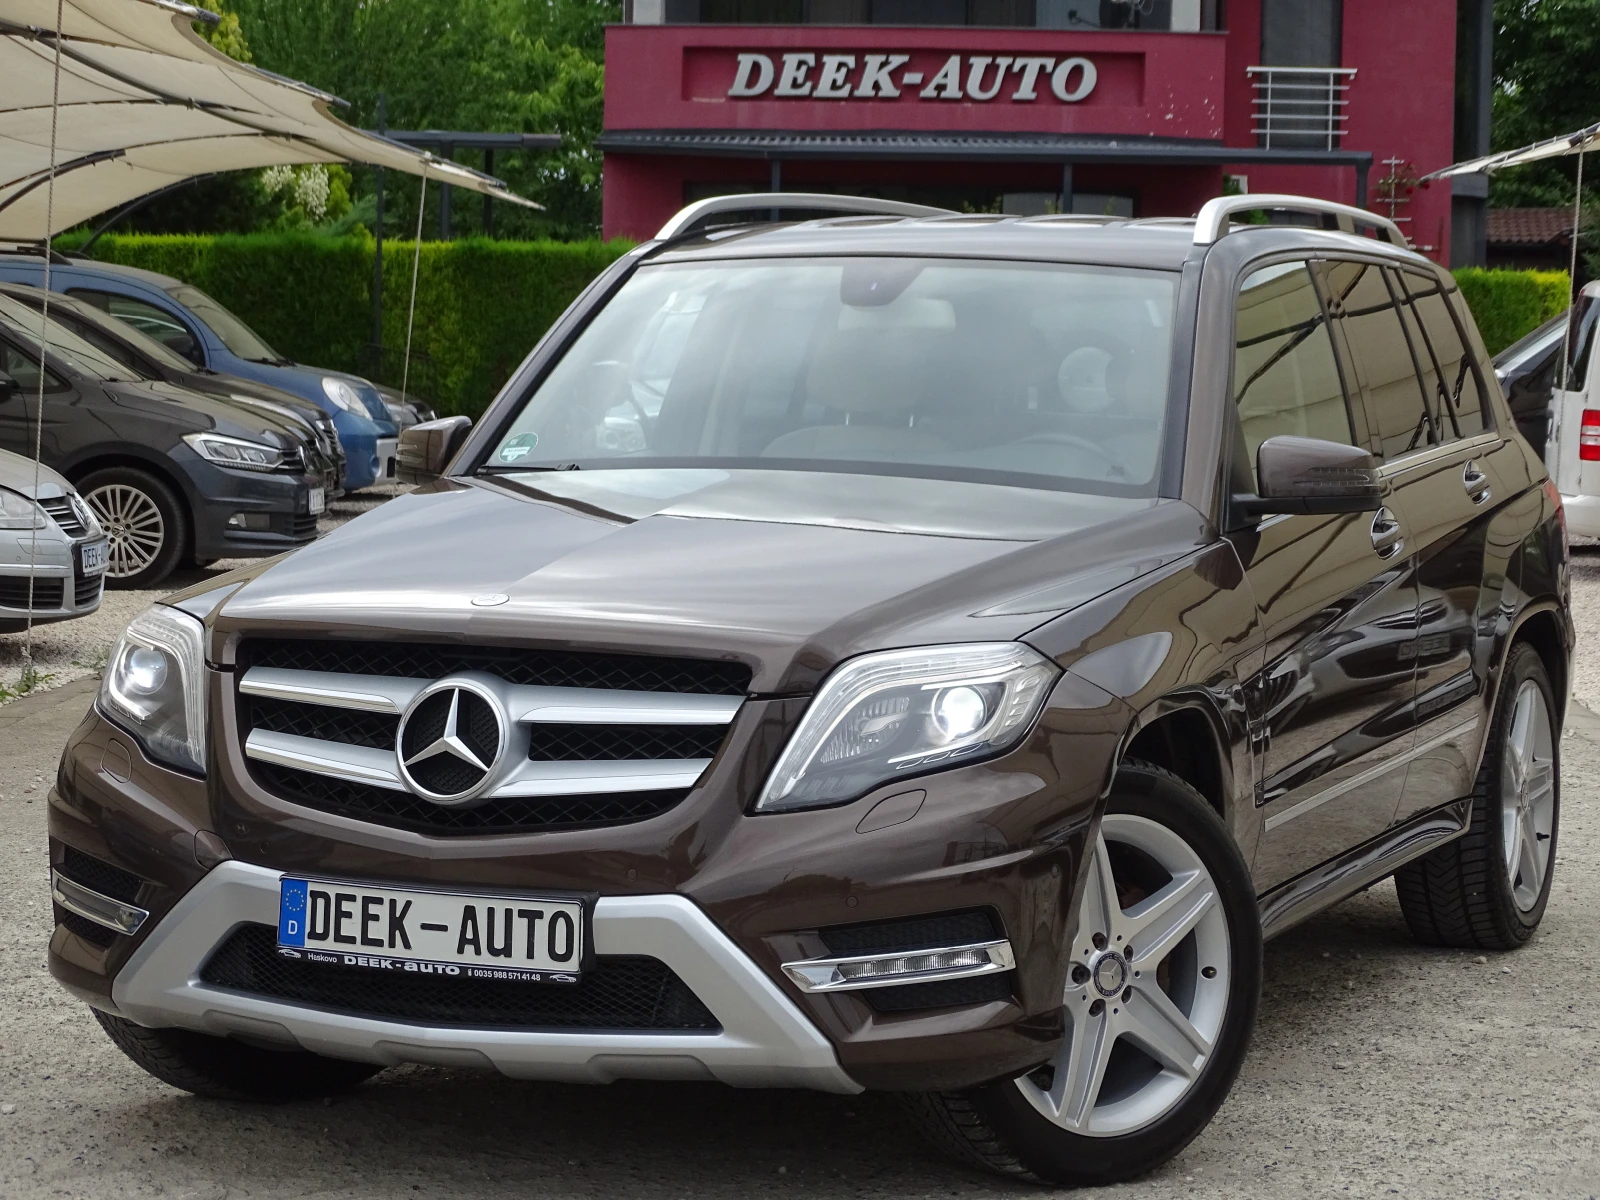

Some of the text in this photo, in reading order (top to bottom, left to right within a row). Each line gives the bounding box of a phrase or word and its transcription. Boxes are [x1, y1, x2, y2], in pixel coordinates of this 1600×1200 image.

[728, 53, 1097, 101] DEEK-AUTO
[288, 920, 298, 935] D
[308, 952, 338, 963] Haskovo
